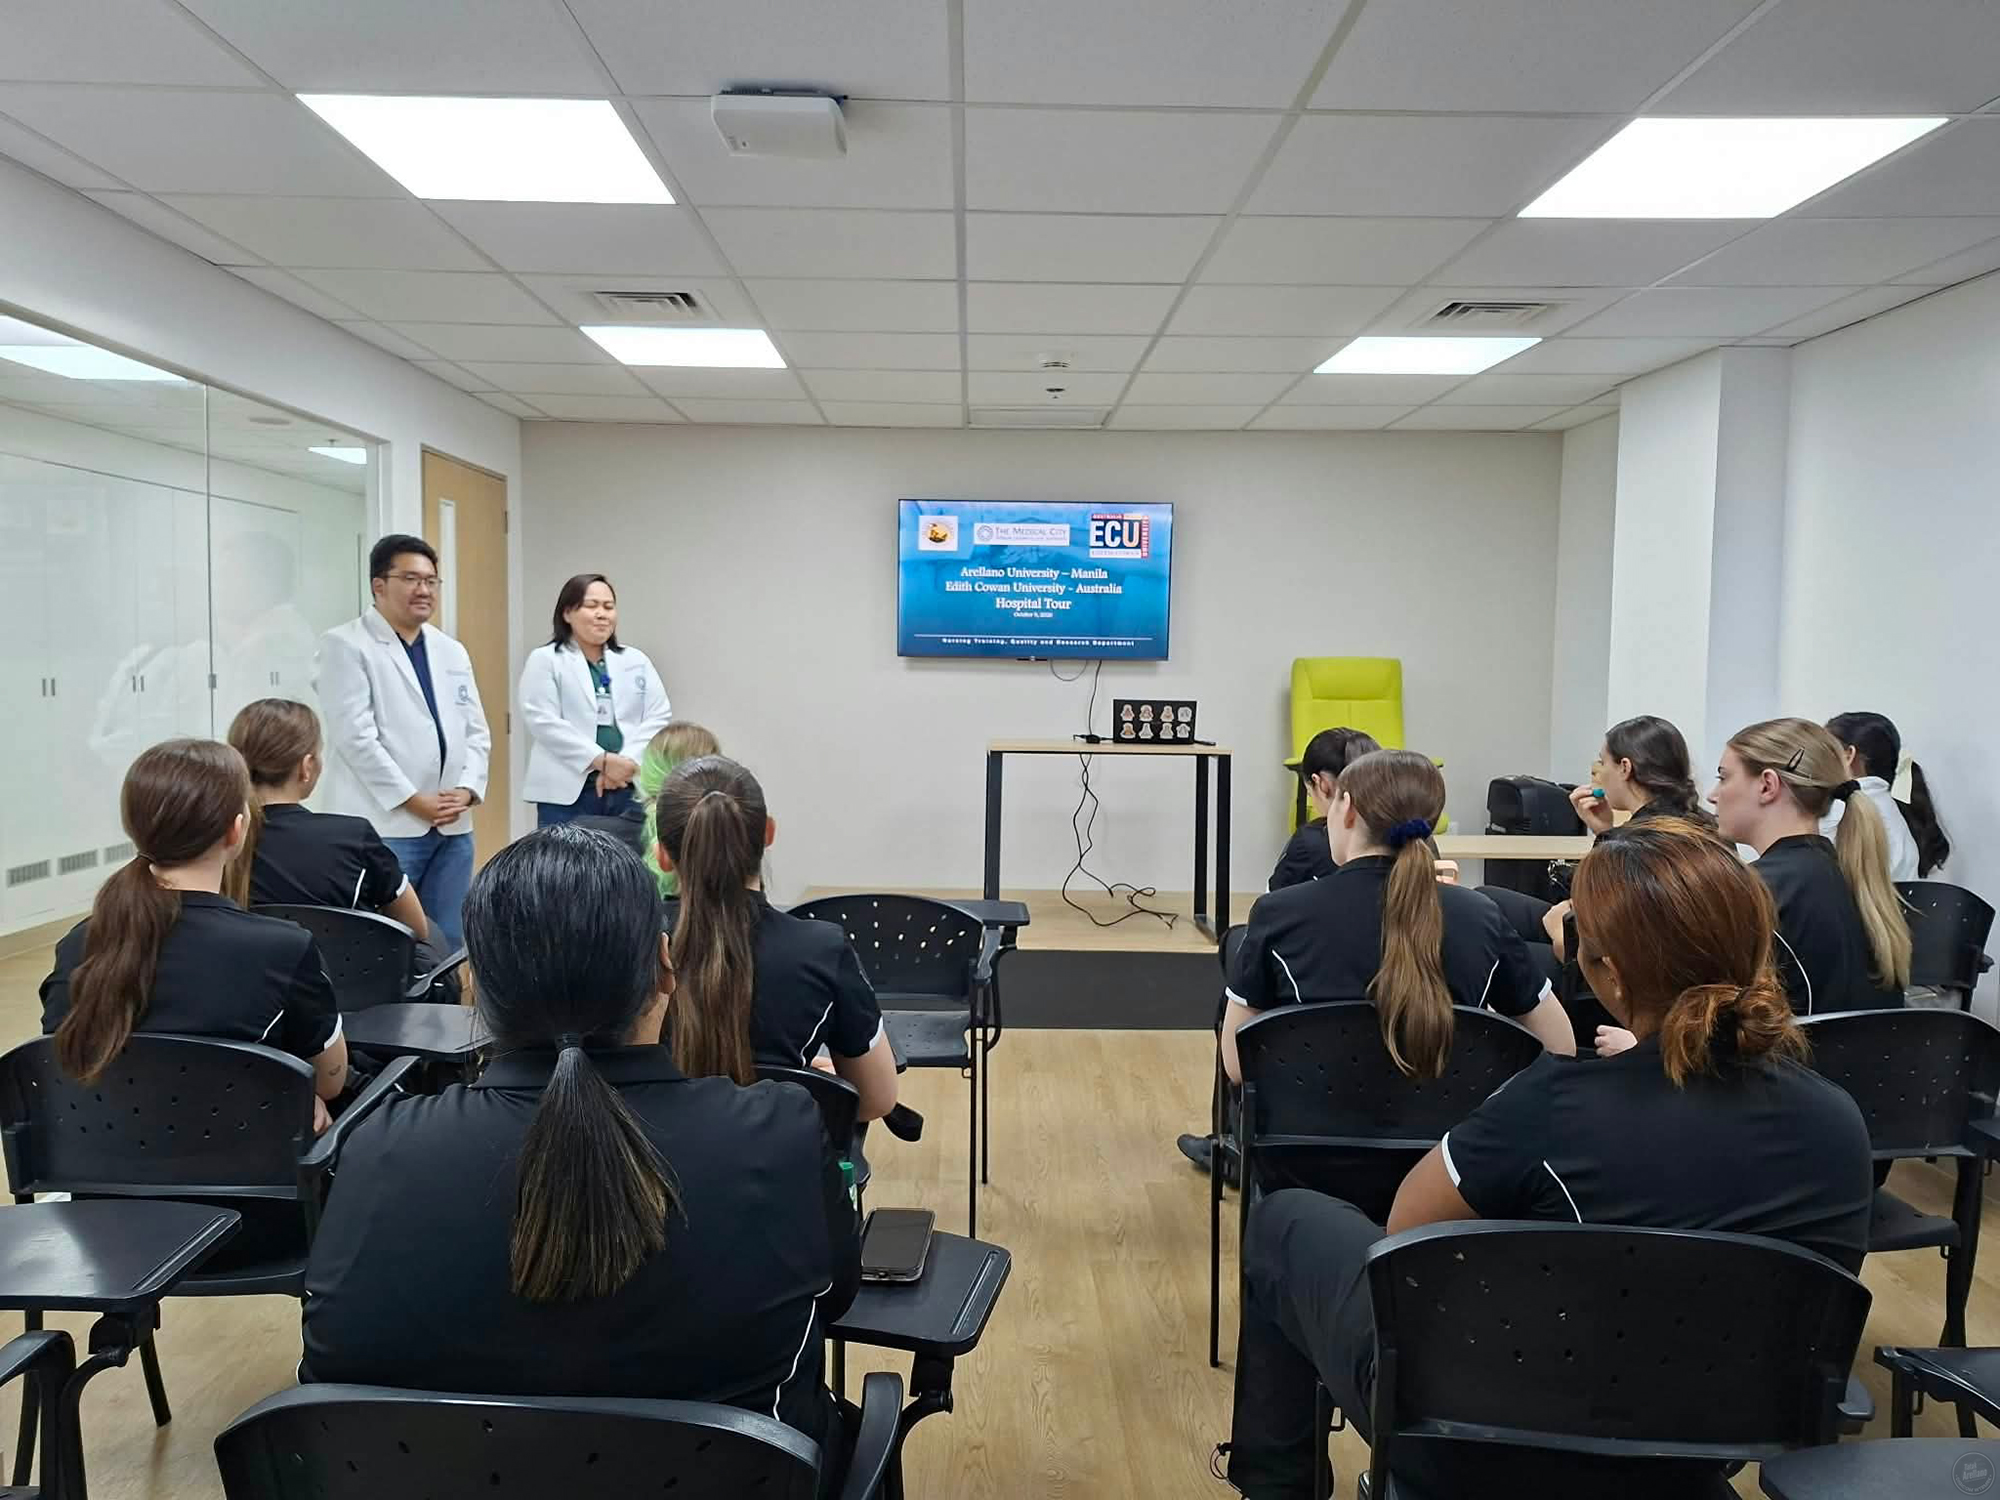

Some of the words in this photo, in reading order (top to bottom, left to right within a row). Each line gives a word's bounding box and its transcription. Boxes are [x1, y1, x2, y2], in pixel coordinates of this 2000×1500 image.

[1090, 520, 1140, 547] ECU
[961, 566, 1005, 577] Arellano
[1007, 567, 1060, 580] University
[1070, 567, 1108, 579] Manila
[945, 580, 973, 592] Edith
[974, 581, 1010, 592] Cowan
[1013, 582, 1066, 595] University
[1075, 583, 1122, 594] Australia
[996, 597, 1041, 611] Hospital
[1043, 597, 1072, 609] Tour
